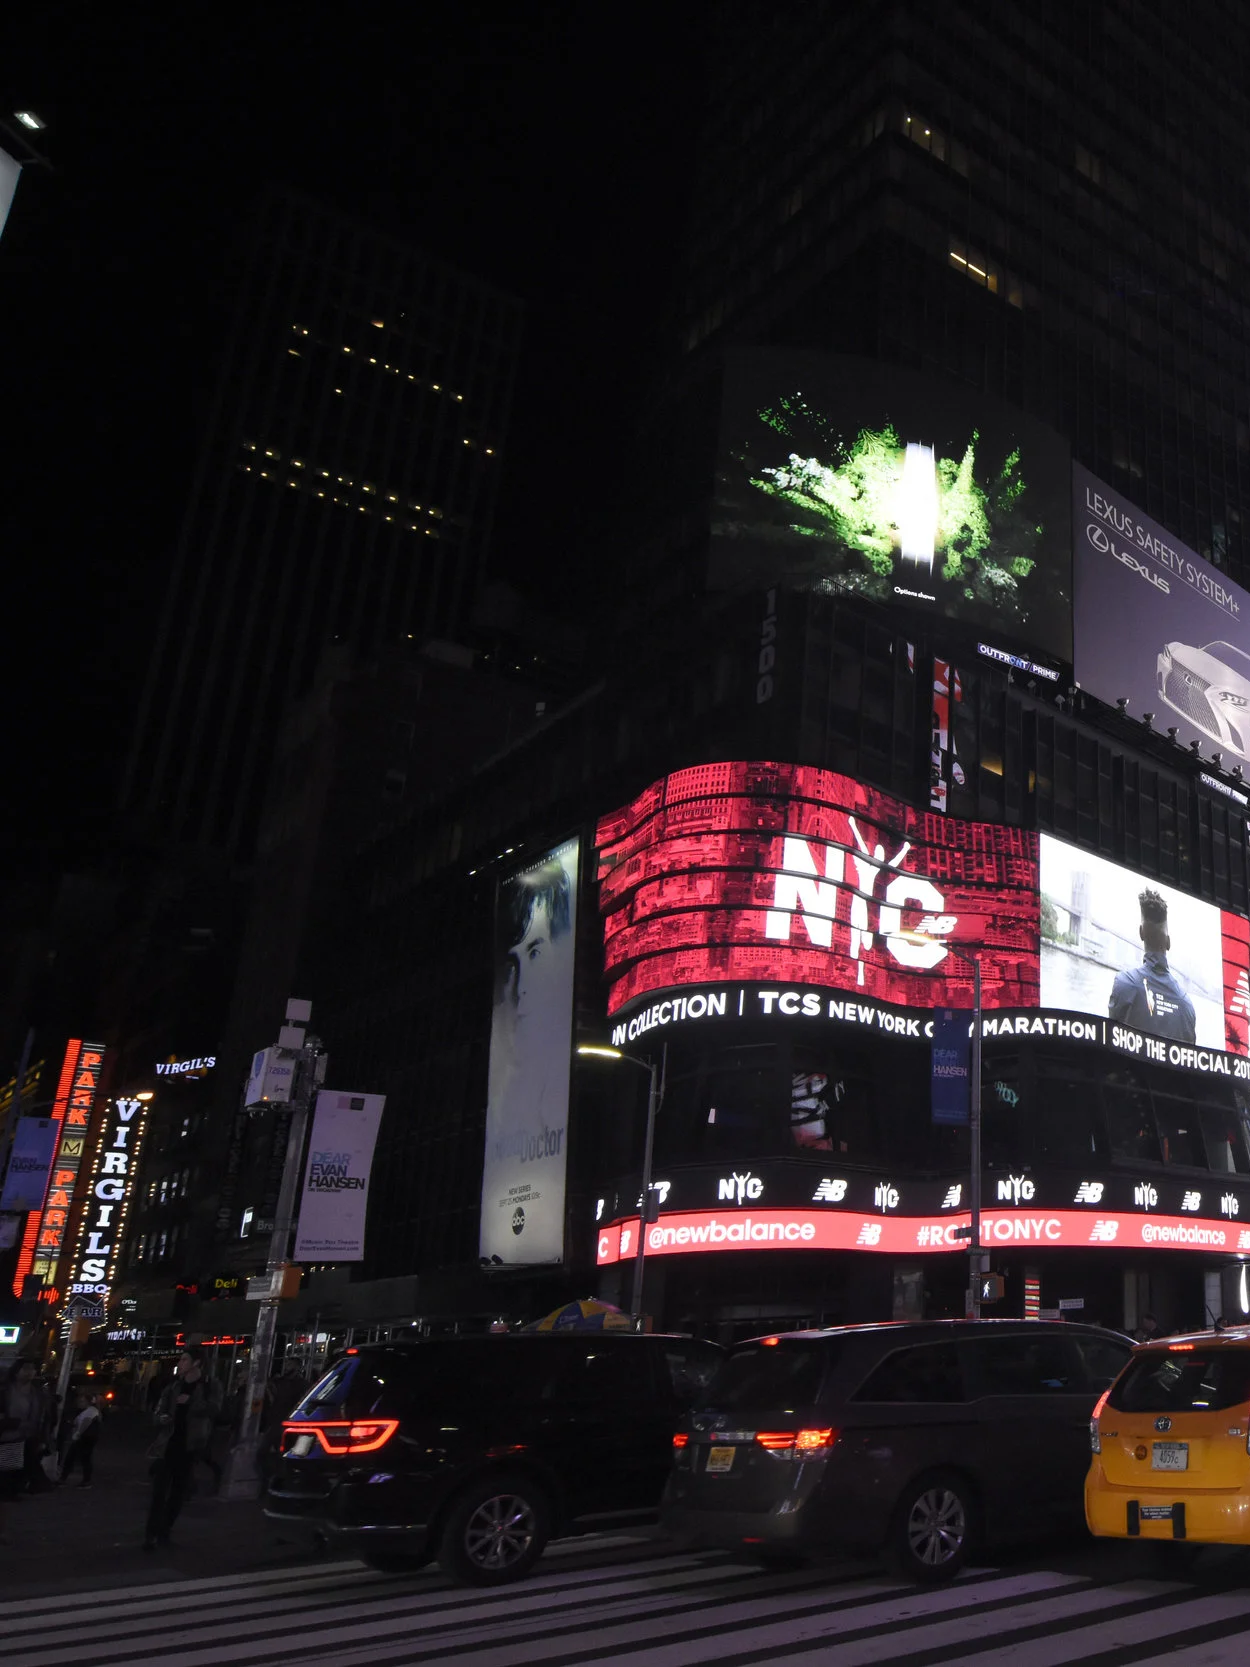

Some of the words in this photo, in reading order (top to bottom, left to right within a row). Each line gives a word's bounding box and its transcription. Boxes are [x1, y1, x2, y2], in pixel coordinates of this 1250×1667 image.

[1086, 487, 1134, 538] LEXUS
[1136, 525, 1185, 575] SAFETY
[1186, 563, 1240, 613] SYSTEM+
[1110, 542, 1171, 594] LEXUS
[894, 586, 917, 597] Options
[917, 591, 936, 601] shown
[756, 588, 777, 704] 1500
[979, 644, 1028, 670] OUTFRONT
[1032, 664, 1058, 680] PRIME
[628, 992, 727, 1042] COLLECTION
[758, 991, 821, 1016] TCS
[828, 1000, 877, 1025] NEW
[877, 1010, 920, 1038] YORK
[982, 1017, 1097, 1041] MARATHON
[1111, 1026, 1143, 1055] SHOP
[1145, 1037, 1166, 1062] THE
[1169, 1045, 1232, 1075] OFFICIAL
[155, 1056, 217, 1076] VIRGIL'S
[68, 1052, 101, 1126] PARK
[310, 1163, 348, 1177] EVAN
[312, 1151, 352, 1165] DEAR
[79, 1100, 142, 1283] VIRGILS
[308, 1175, 366, 1190] HANSEN
[41, 1170, 75, 1247] PARK
[648, 1218, 816, 1250] @newbalance
[1141, 1223, 1226, 1247] @newbalance
[71, 1282, 109, 1294] BBQ
[214, 1277, 239, 1289] Deli
